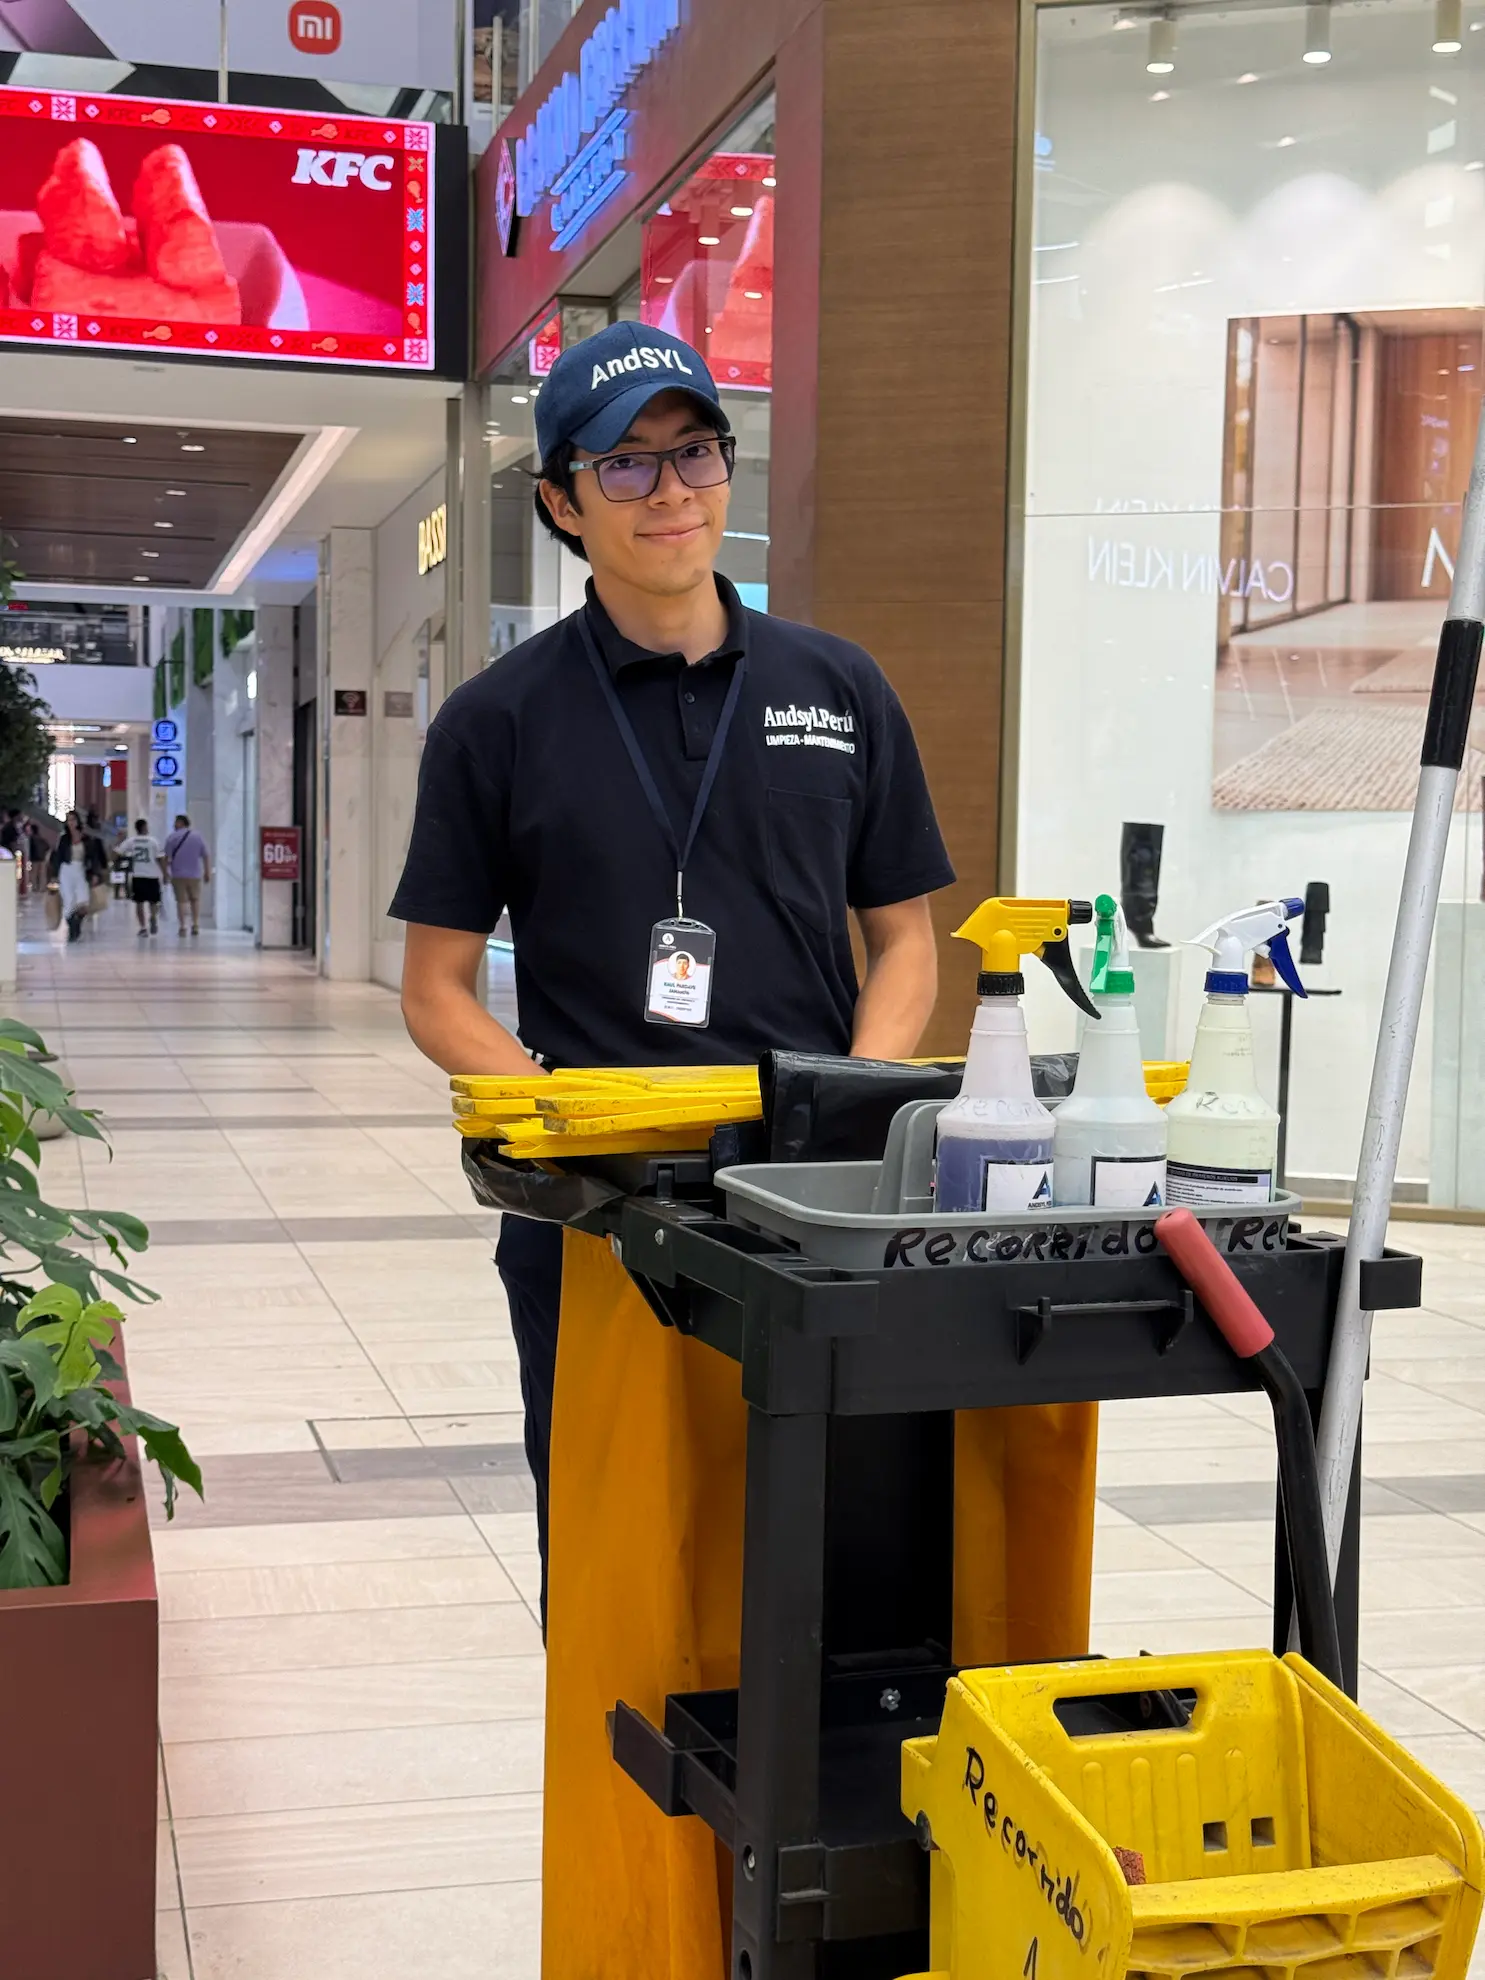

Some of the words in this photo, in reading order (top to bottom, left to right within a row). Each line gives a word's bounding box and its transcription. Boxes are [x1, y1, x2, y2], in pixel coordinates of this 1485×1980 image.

[291, 148, 395, 191] KFC
[590, 346, 693, 391] AndSYL
[263, 843, 284, 864] 60
